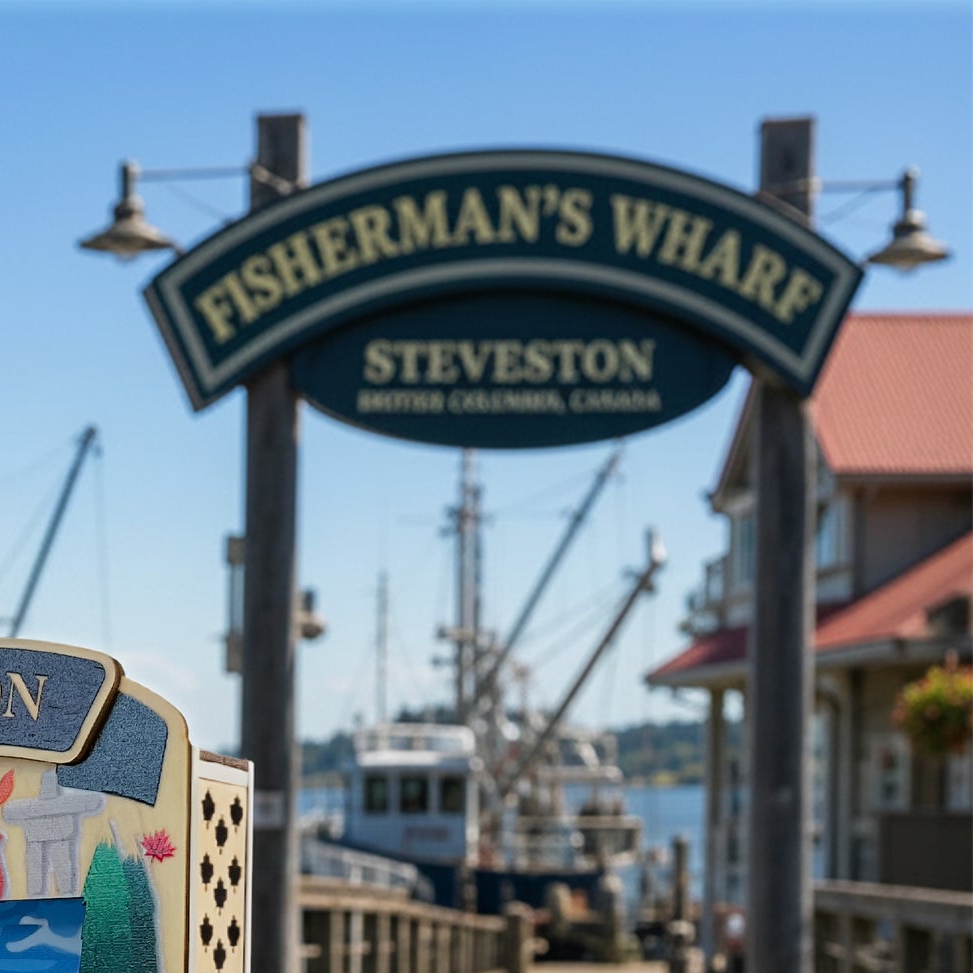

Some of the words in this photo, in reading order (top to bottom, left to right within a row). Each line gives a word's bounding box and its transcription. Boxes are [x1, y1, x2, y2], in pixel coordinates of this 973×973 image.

[195, 184, 593, 344] FISHERMAN'S
[610, 191, 822, 324] WHARF
[363, 338, 655, 384] STEVESTON
